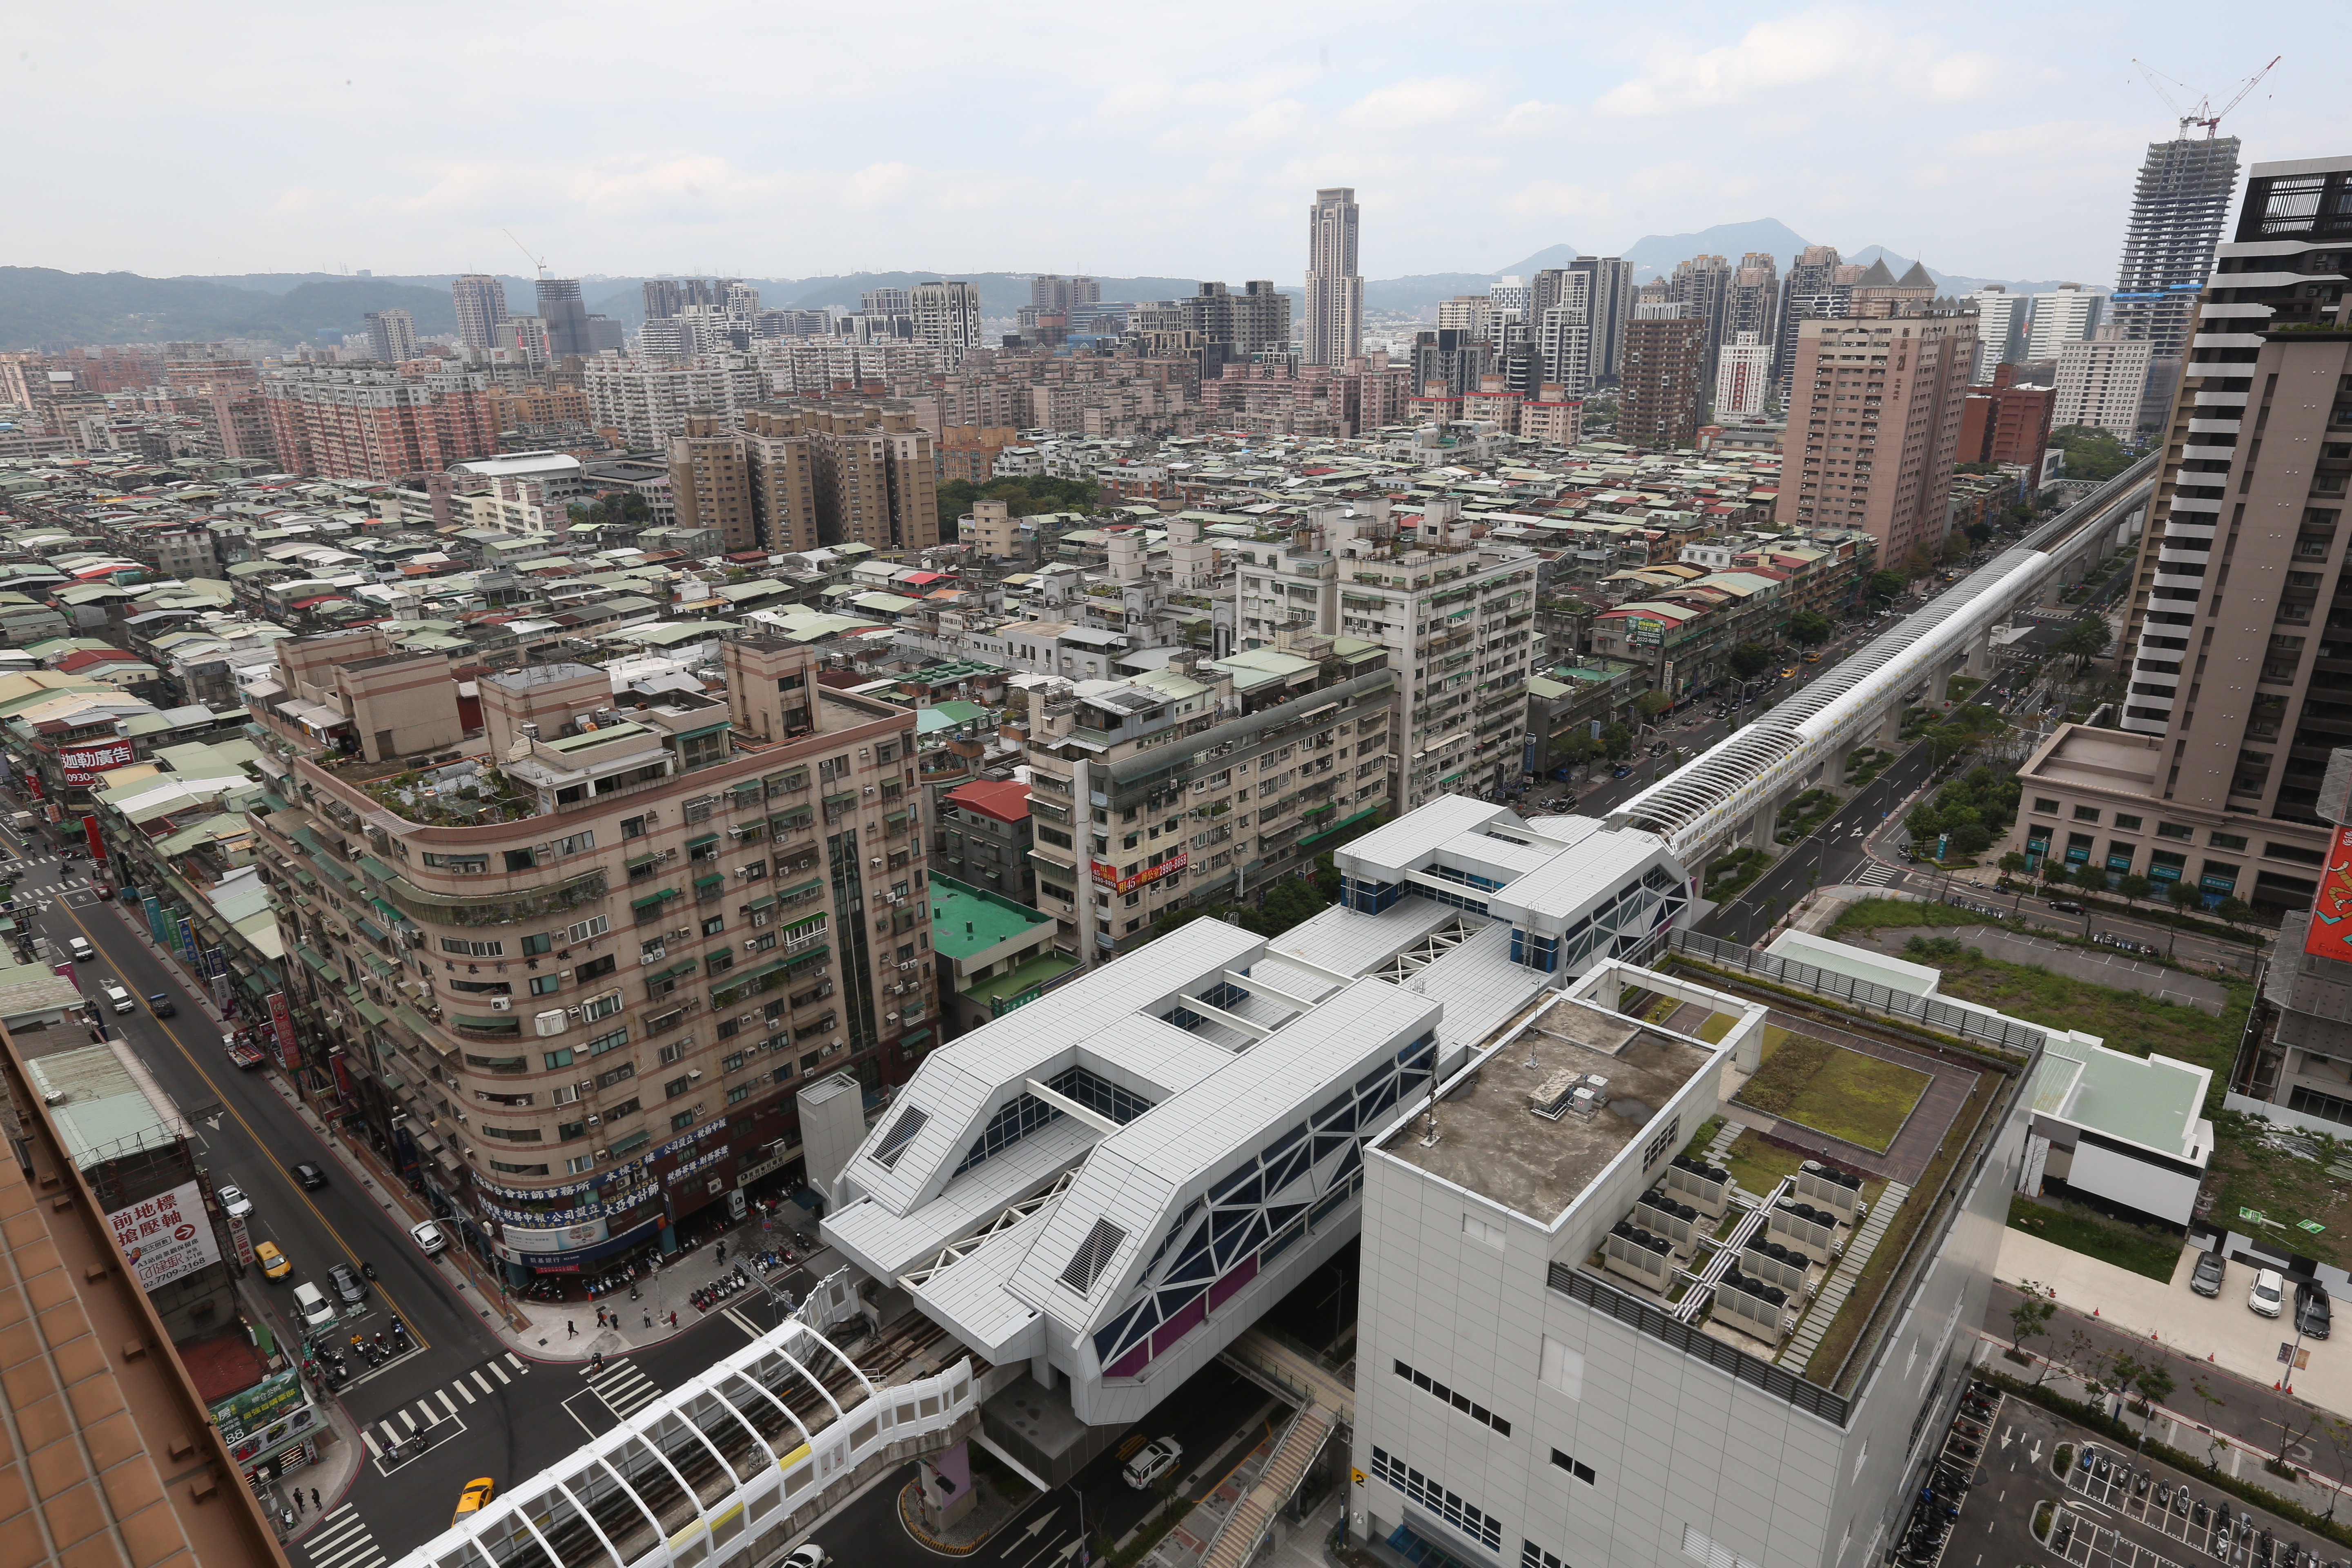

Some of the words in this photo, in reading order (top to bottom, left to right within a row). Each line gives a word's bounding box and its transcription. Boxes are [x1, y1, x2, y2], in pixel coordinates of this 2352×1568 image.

[61, 746, 131, 769] 迦勒廣告
[1160, 855, 1187, 876] 2990-8859
[1092, 875, 1116, 888] 2990-8859
[278, 1021, 296, 1055] 宗教文物
[601, 1175, 658, 1206] 8994-4511
[604, 1182, 659, 1217] 大亞會計師
[111, 1193, 178, 1231] 前地標
[519, 1214, 599, 1228] 8994-4511
[117, 1210, 183, 1246] 搶壓軸
[233, 1227, 246, 1235] SYM
[143, 1257, 205, 1288] 02.7709-2168
[1355, 1474, 1365, 1488] 2
